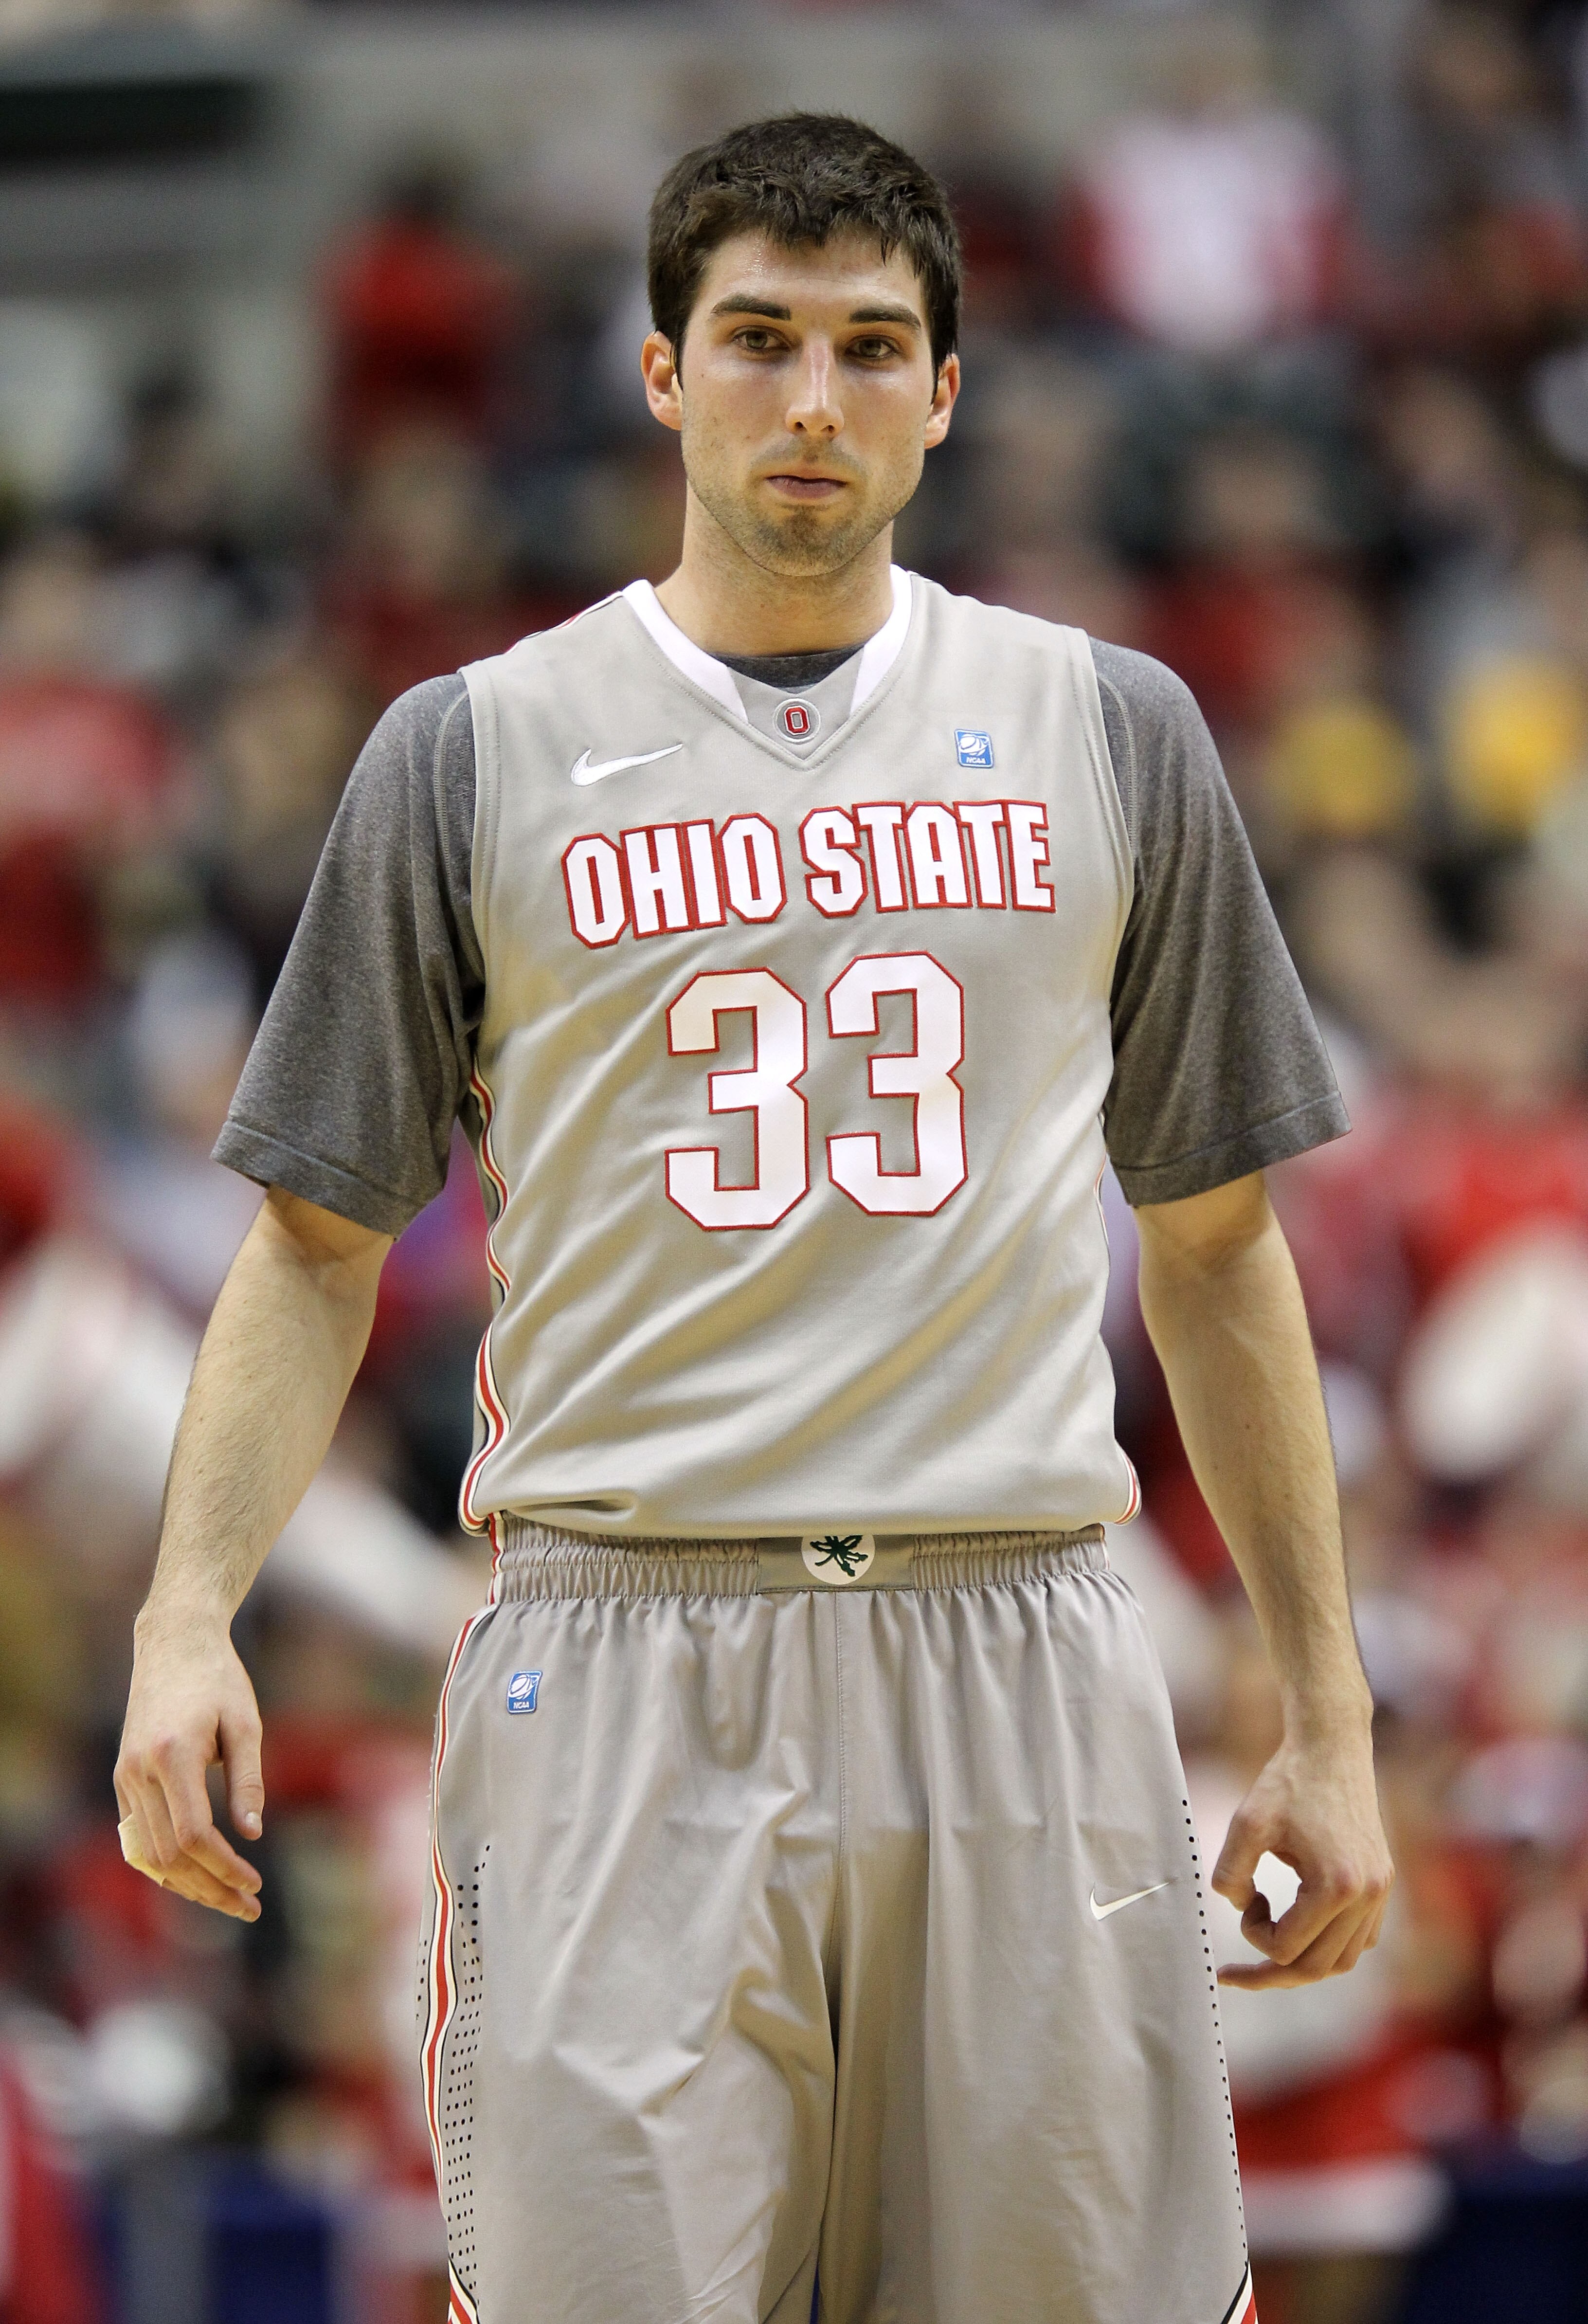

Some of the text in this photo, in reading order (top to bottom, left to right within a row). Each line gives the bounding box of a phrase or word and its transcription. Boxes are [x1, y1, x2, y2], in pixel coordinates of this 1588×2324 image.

[784, 705, 810, 736] O
[561, 799, 1056, 949] OHIO STATE
[665, 950, 969, 1231] 33
